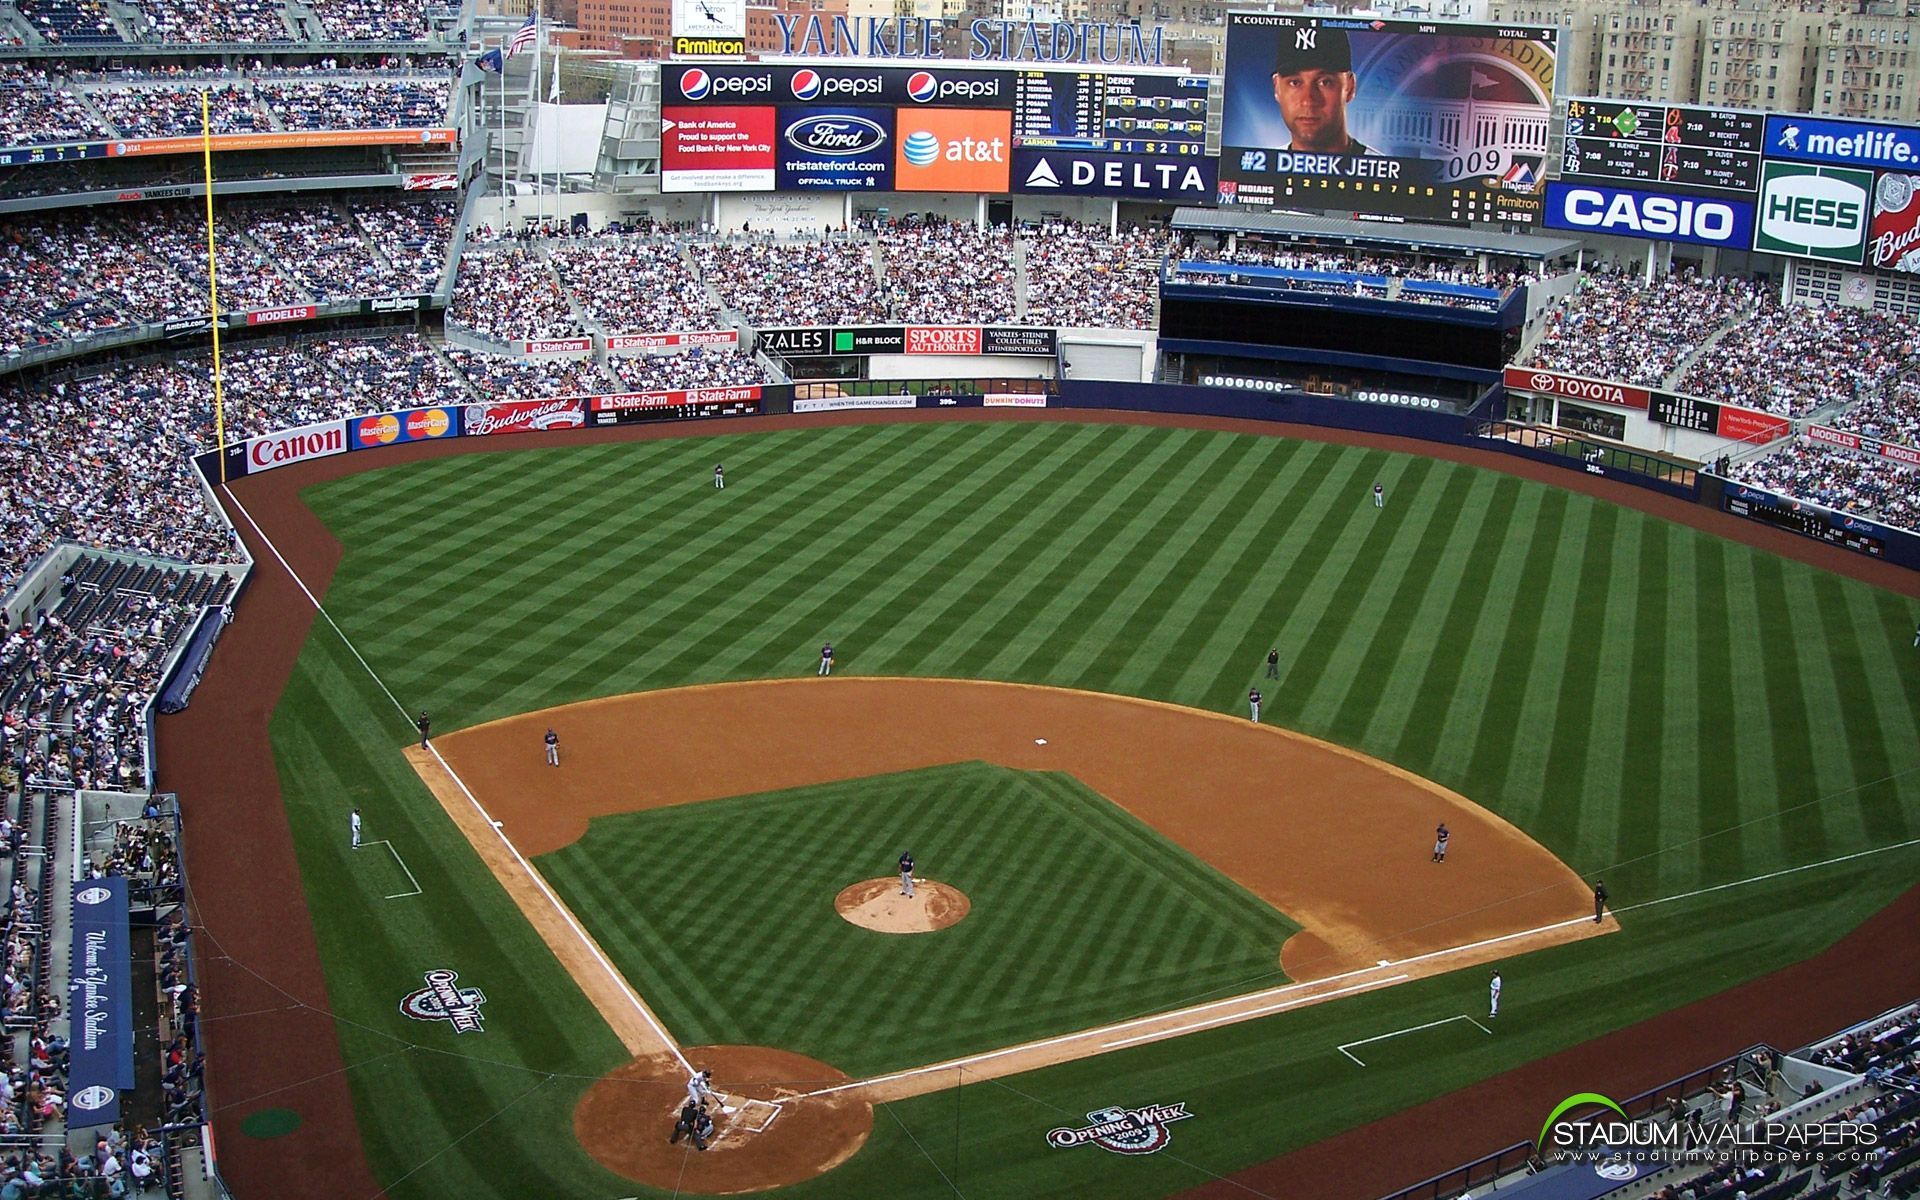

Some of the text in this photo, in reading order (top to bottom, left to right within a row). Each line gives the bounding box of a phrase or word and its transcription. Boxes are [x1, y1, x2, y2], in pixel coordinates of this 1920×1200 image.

[774, 13, 1164, 65] YANKEE STADIUM
[1498, 29, 1550, 40] TOTAL: 3
[677, 38, 743, 54] Armitron
[713, 73, 772, 95] pepsi
[824, 75, 882, 96] pepsi
[939, 78, 999, 99] pepsi
[1107, 77, 1135, 86] DEREK
[1106, 86, 1132, 94] JETER
[1589, 106, 1596, 115] 2
[678, 121, 737, 129] Bank of America
[1589, 122, 1596, 131] 2
[678, 133, 749, 142] Proud to support the
[809, 123, 863, 146] Ford
[678, 145, 695, 153] Food
[696, 145, 714, 153] Bank
[742, 144, 758, 152] York
[758, 144, 771, 153] City
[945, 138, 1005, 163] at&t
[1126, 141, 1198, 154] 1 S 2 0
[786, 161, 885, 171] tristateford.com
[1241, 152, 1401, 179] #2 DEREK JETER
[1072, 159, 1206, 192] DELTA
[1239, 184, 1274, 194] INDIANS
[1303, 179, 1310, 187] 2
[1321, 180, 1328, 188] 3
[1391, 185, 1398, 193] 7
[119, 188, 191, 200] Audi YANKEES CLUB
[1238, 195, 1274, 205] YANKEES
[1497, 195, 1539, 209] Armitron
[1564, 189, 1734, 240] CASIO
[1768, 194, 1860, 230] HESS
[372, 298, 419, 310] Poland Spring
[257, 308, 307, 322] MODELL'S
[165, 319, 206, 331] Amtrak.com
[764, 332, 822, 349] ZALES
[855, 336, 901, 345] H&R BLOCK
[910, 330, 977, 344] SPORTS
[988, 345, 1050, 353] STEINERSPORTS.COM
[1557, 378, 1625, 403] TOYOTA
[1675, 398, 1694, 410] THE
[474, 400, 568, 436] Budweiser
[1659, 403, 1708, 423] SHARPER
[1665, 414, 1700, 429] IMAGE
[1811, 427, 1856, 447] MODELL'S
[252, 428, 342, 466] Canon
[86, 930, 107, 969] Welcome
[74, 974, 108, 1010] Yankee
[84, 1010, 108, 1050] Stadium
[1115, 1129, 1142, 1141] 2009
